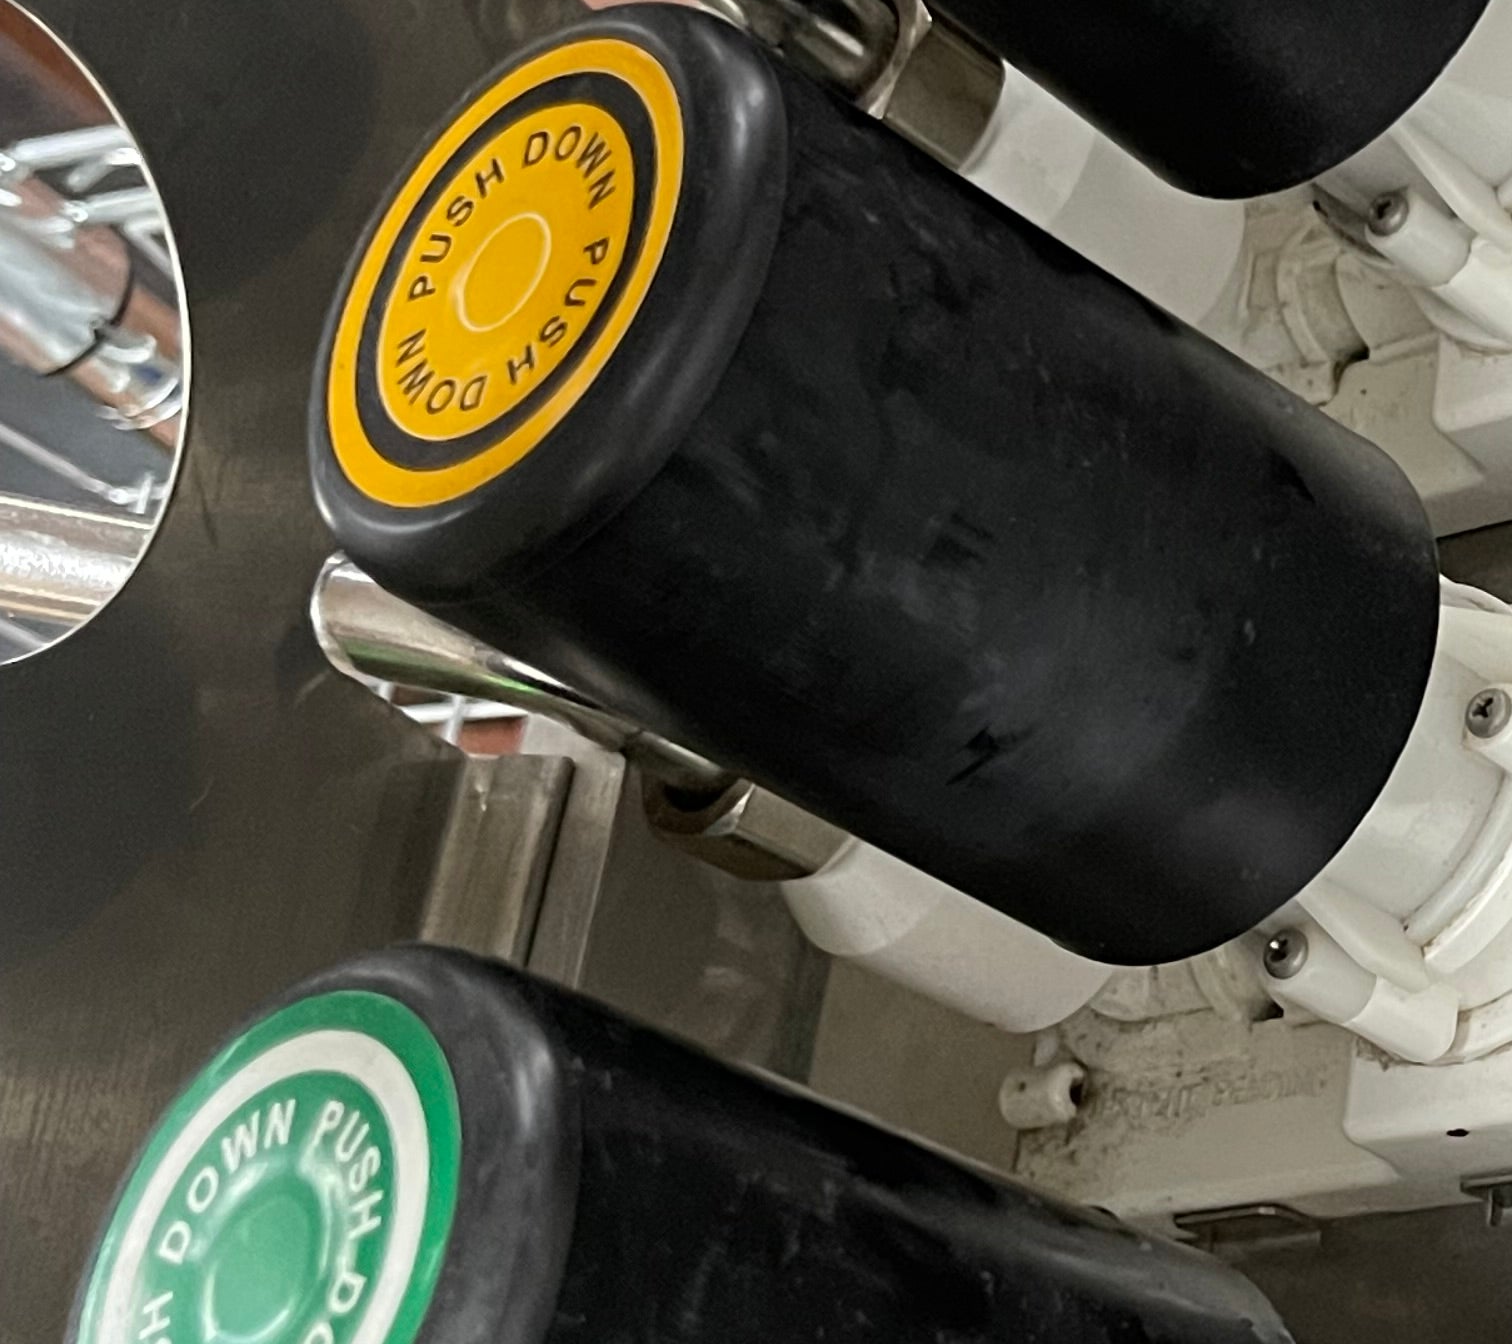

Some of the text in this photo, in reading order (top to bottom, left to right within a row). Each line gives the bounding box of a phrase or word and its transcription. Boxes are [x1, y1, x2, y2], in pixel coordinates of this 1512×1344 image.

[408, 126, 615, 301] PUSH DOWN
[396, 237, 609, 415] PUSH DOWN
[157, 1099, 296, 1264] DOWN
[316, 1100, 382, 1238] PUSH
